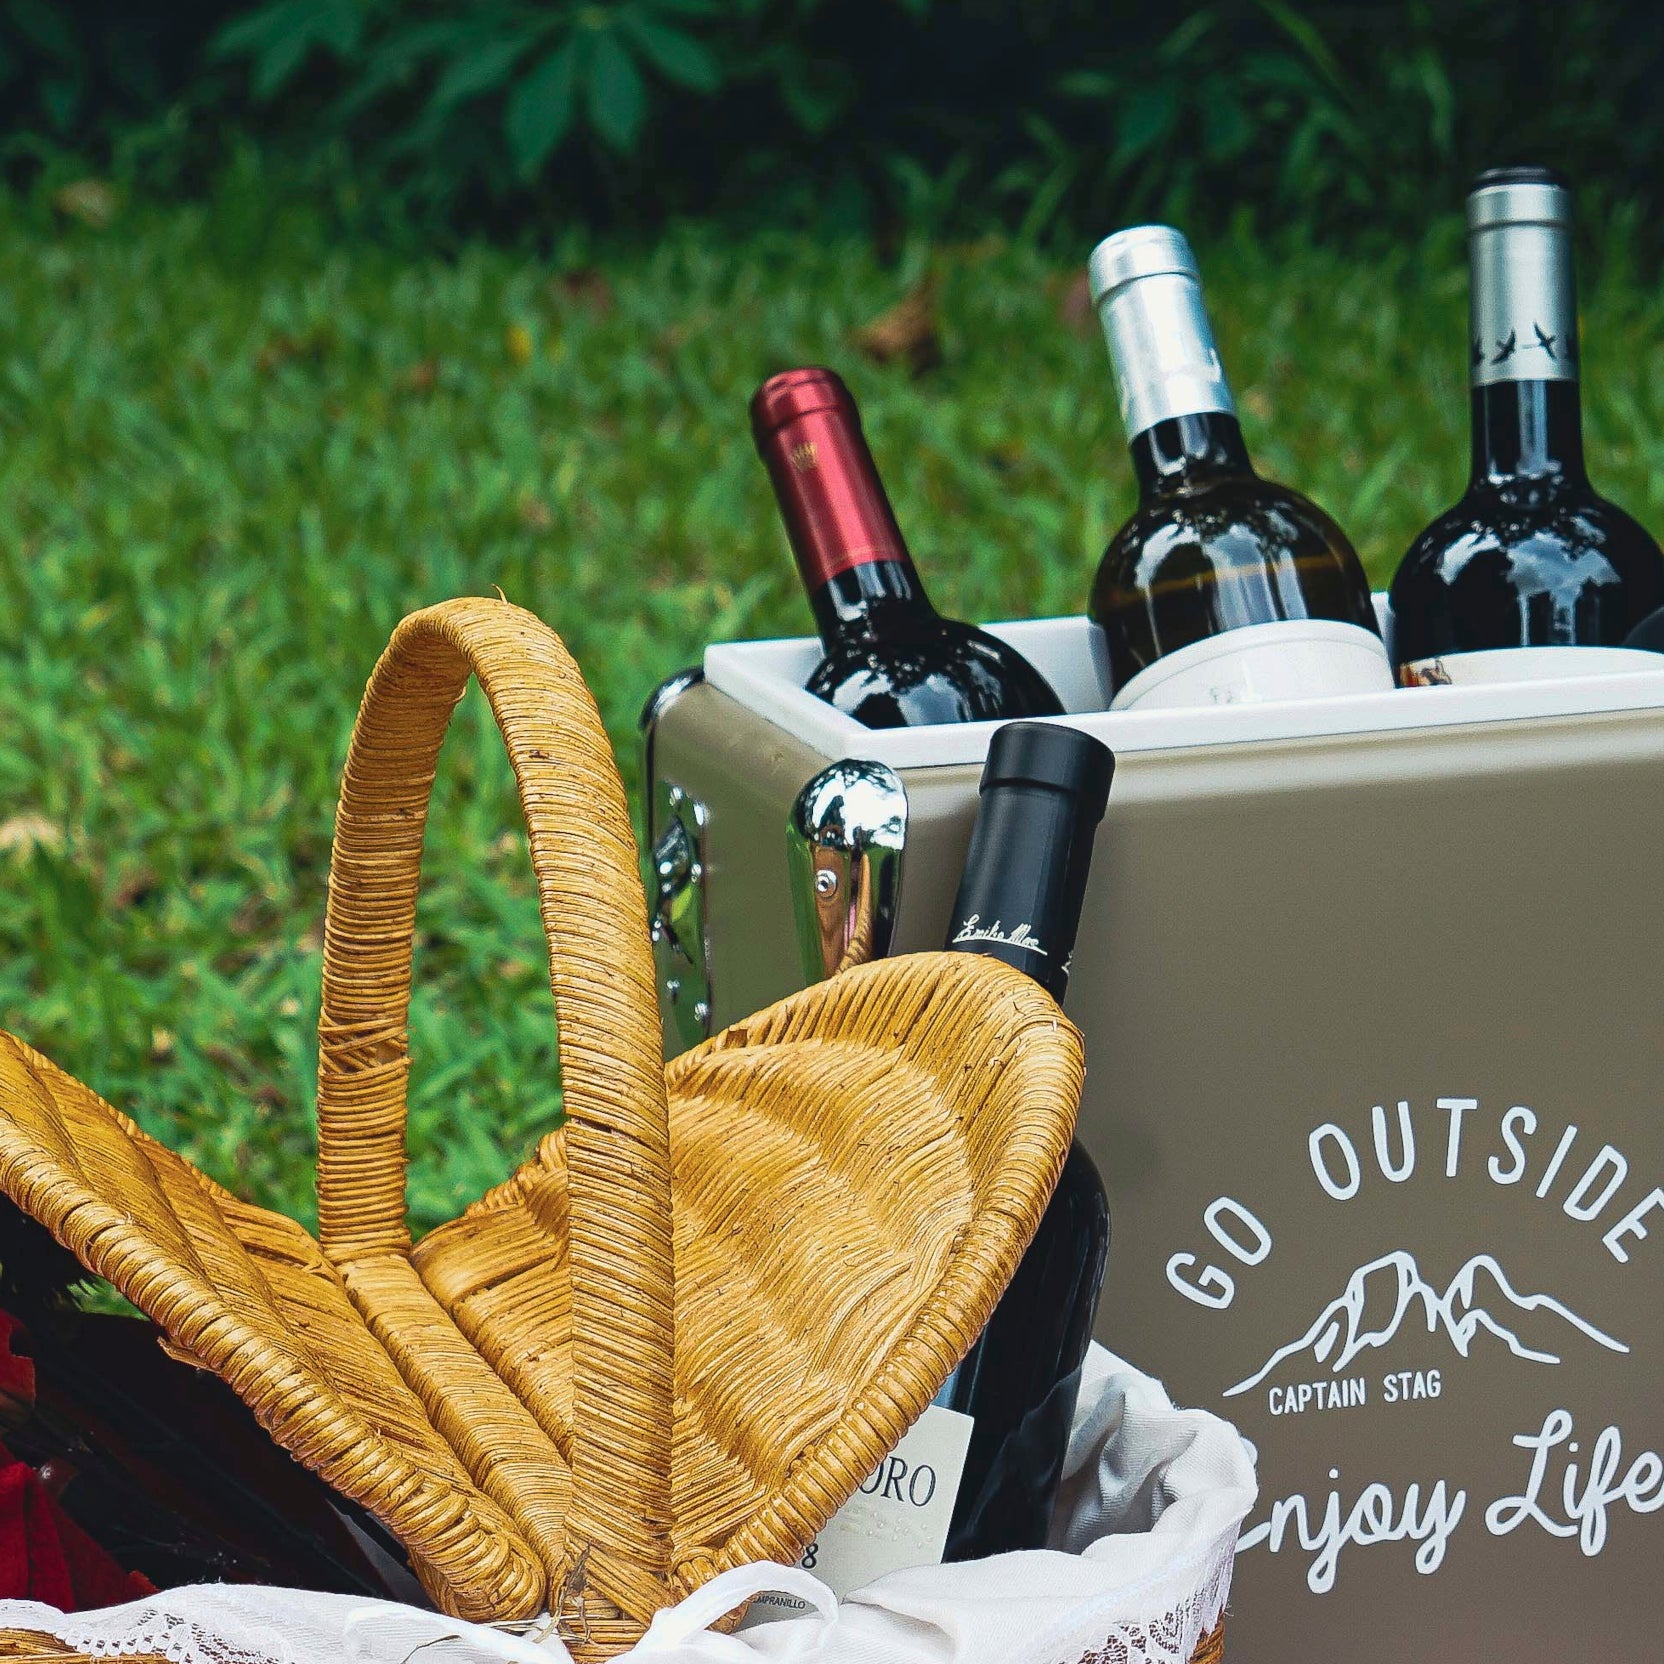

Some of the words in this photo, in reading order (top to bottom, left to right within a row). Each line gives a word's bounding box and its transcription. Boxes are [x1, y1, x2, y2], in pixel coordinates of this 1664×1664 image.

[1166, 1196, 1272, 1310] GO
[1268, 1377, 1366, 1415] CAPTAIN
[1383, 1369, 1442, 1402] STAG
[859, 1454, 937, 1508] ORO
[1236, 1468, 1467, 1594] njoy
